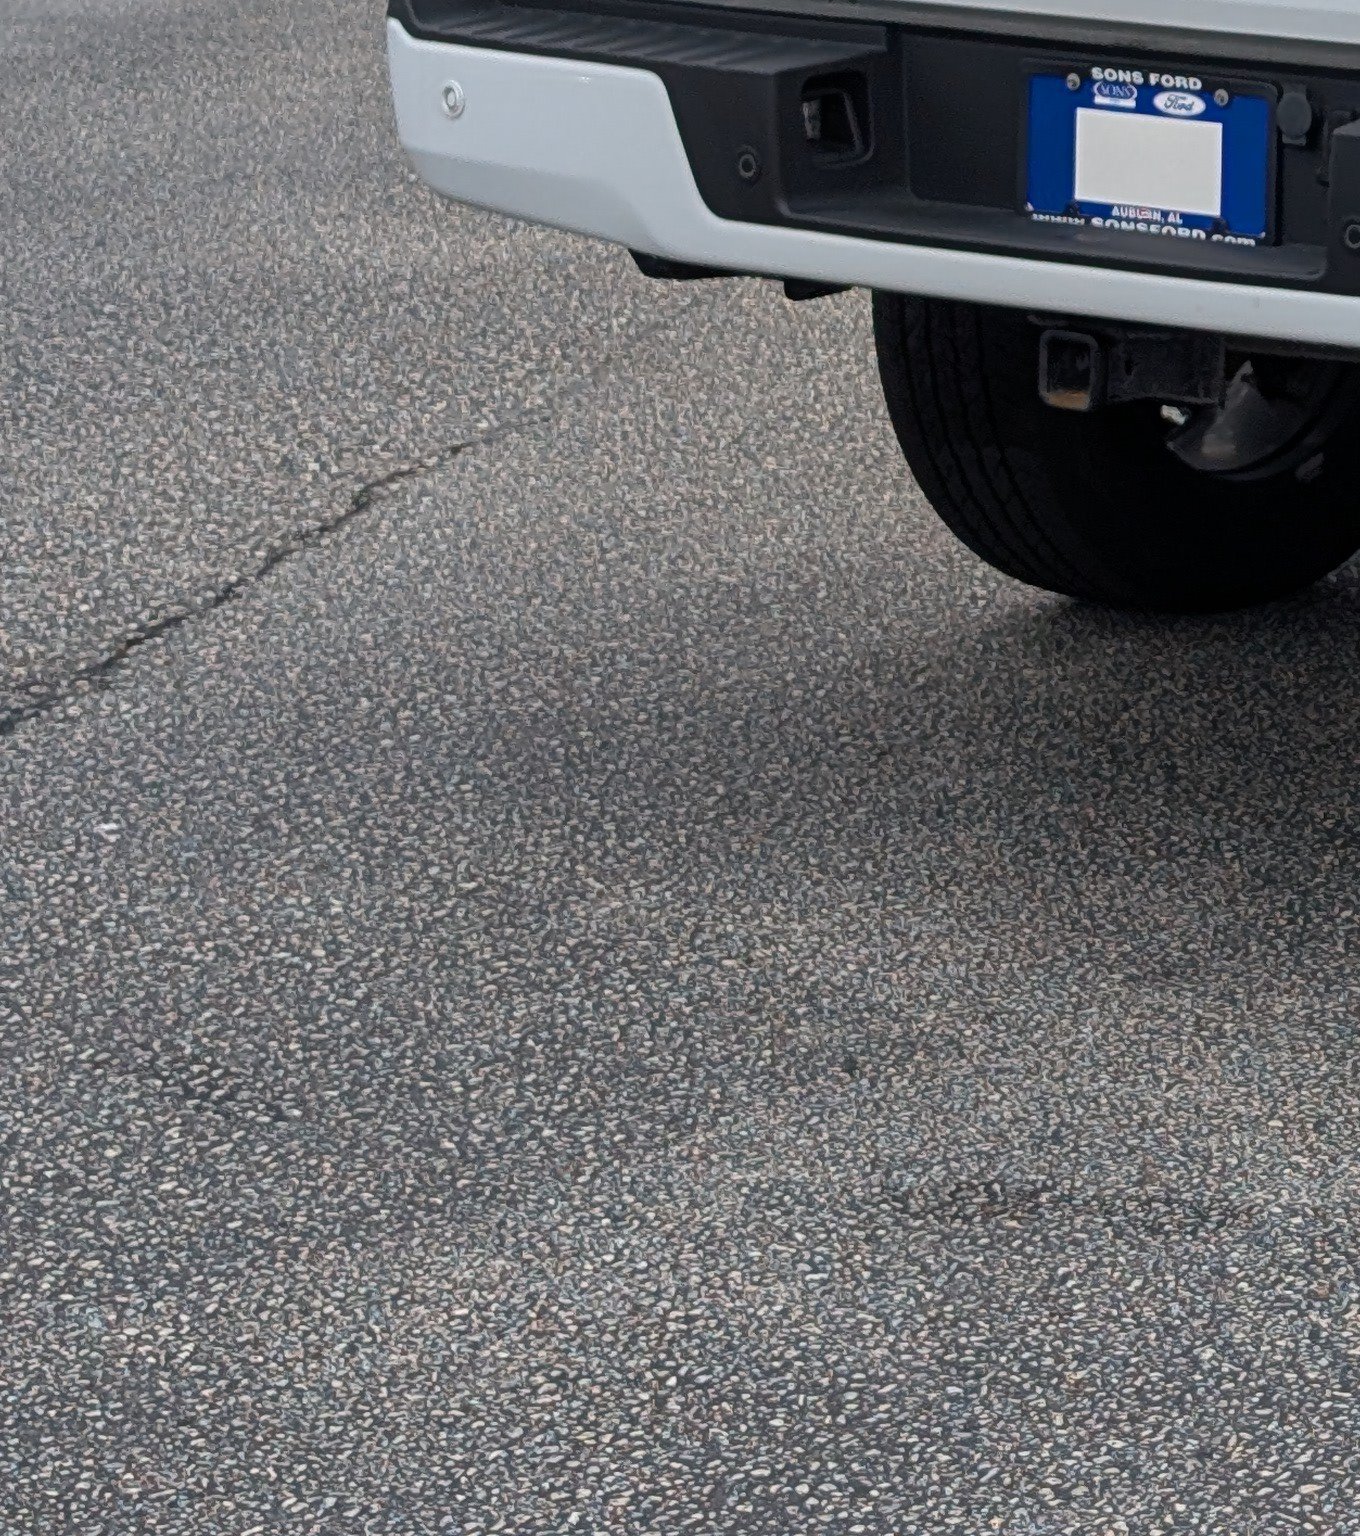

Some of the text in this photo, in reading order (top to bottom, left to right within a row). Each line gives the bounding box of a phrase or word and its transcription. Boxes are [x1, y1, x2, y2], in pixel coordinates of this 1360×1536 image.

[1091, 67, 1203, 91] SONS FORD
[1032, 213, 1257, 247] wwwSONSFORDcom
